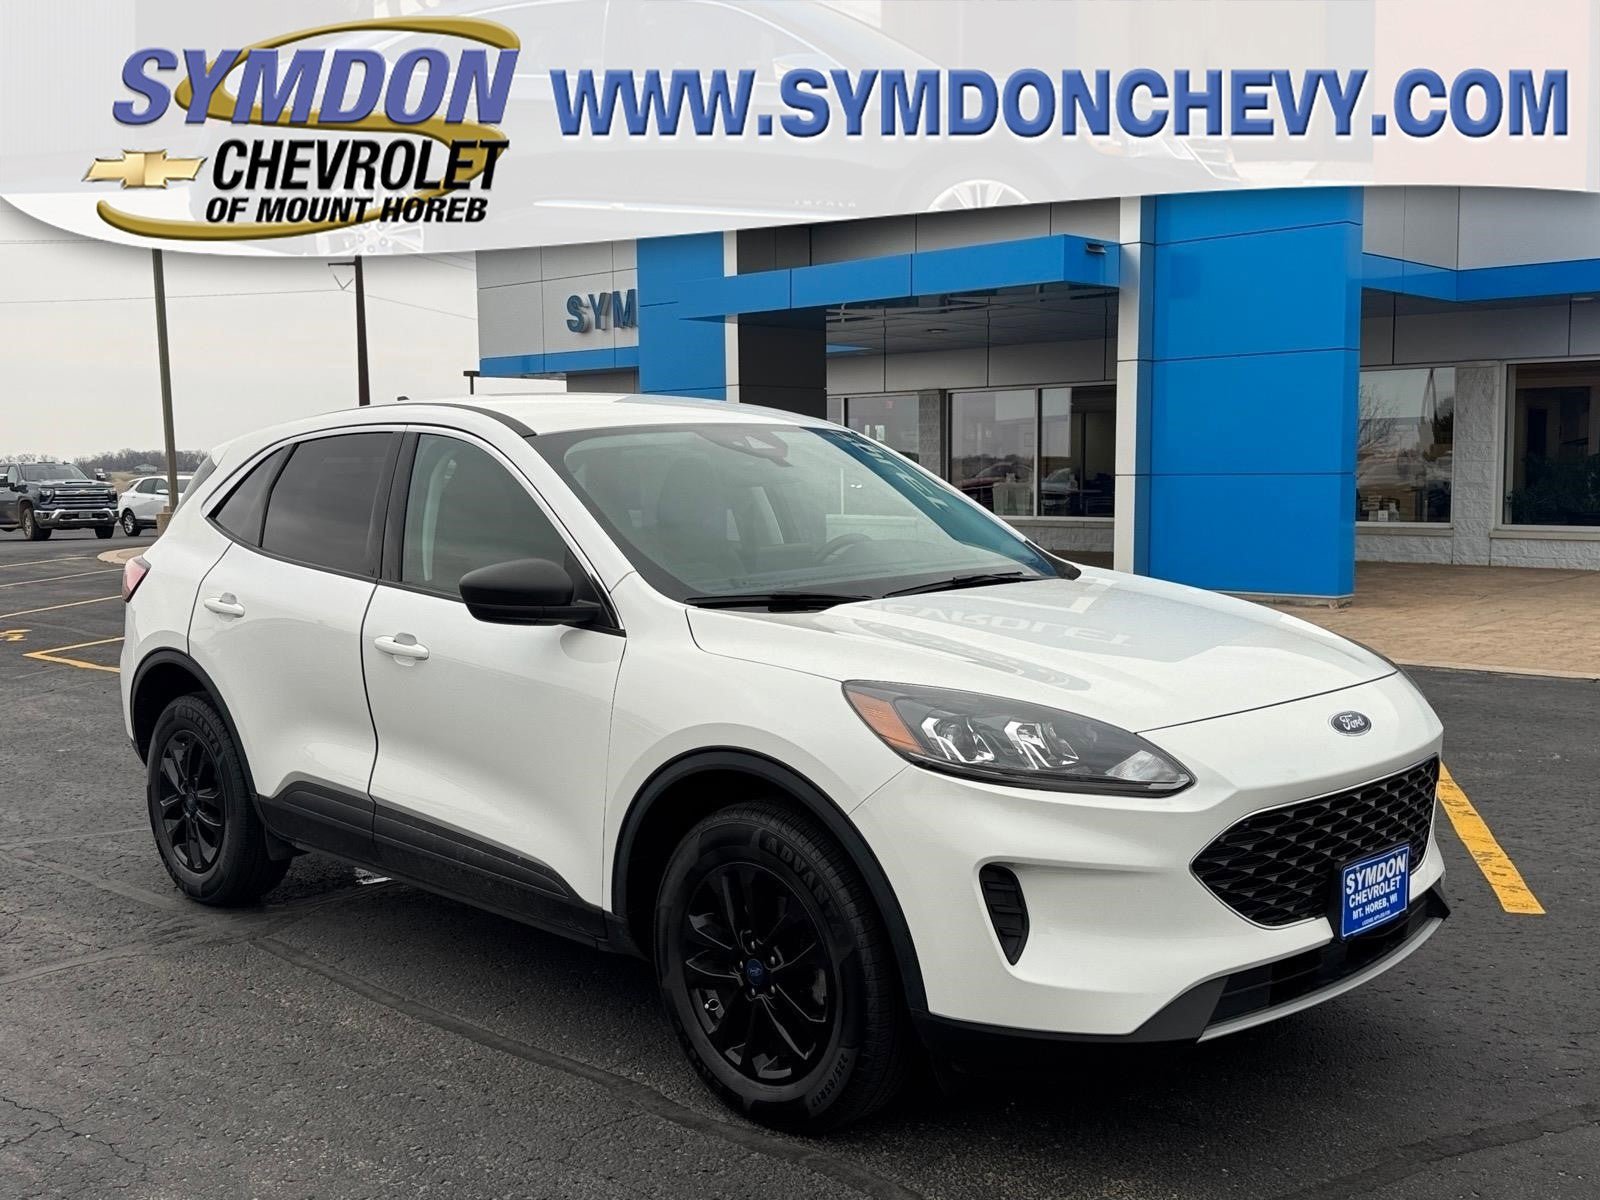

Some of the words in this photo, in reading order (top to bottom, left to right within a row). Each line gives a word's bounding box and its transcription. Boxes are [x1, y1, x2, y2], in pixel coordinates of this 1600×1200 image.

[1340, 714, 1365, 730] Ford
[1346, 853, 1406, 895] SYMDON
[1349, 876, 1402, 908] CHEVROLET
[1352, 907, 1364, 921] MT.
[1365, 897, 1390, 915] HOREB,
[1390, 892, 1398, 904] WI
